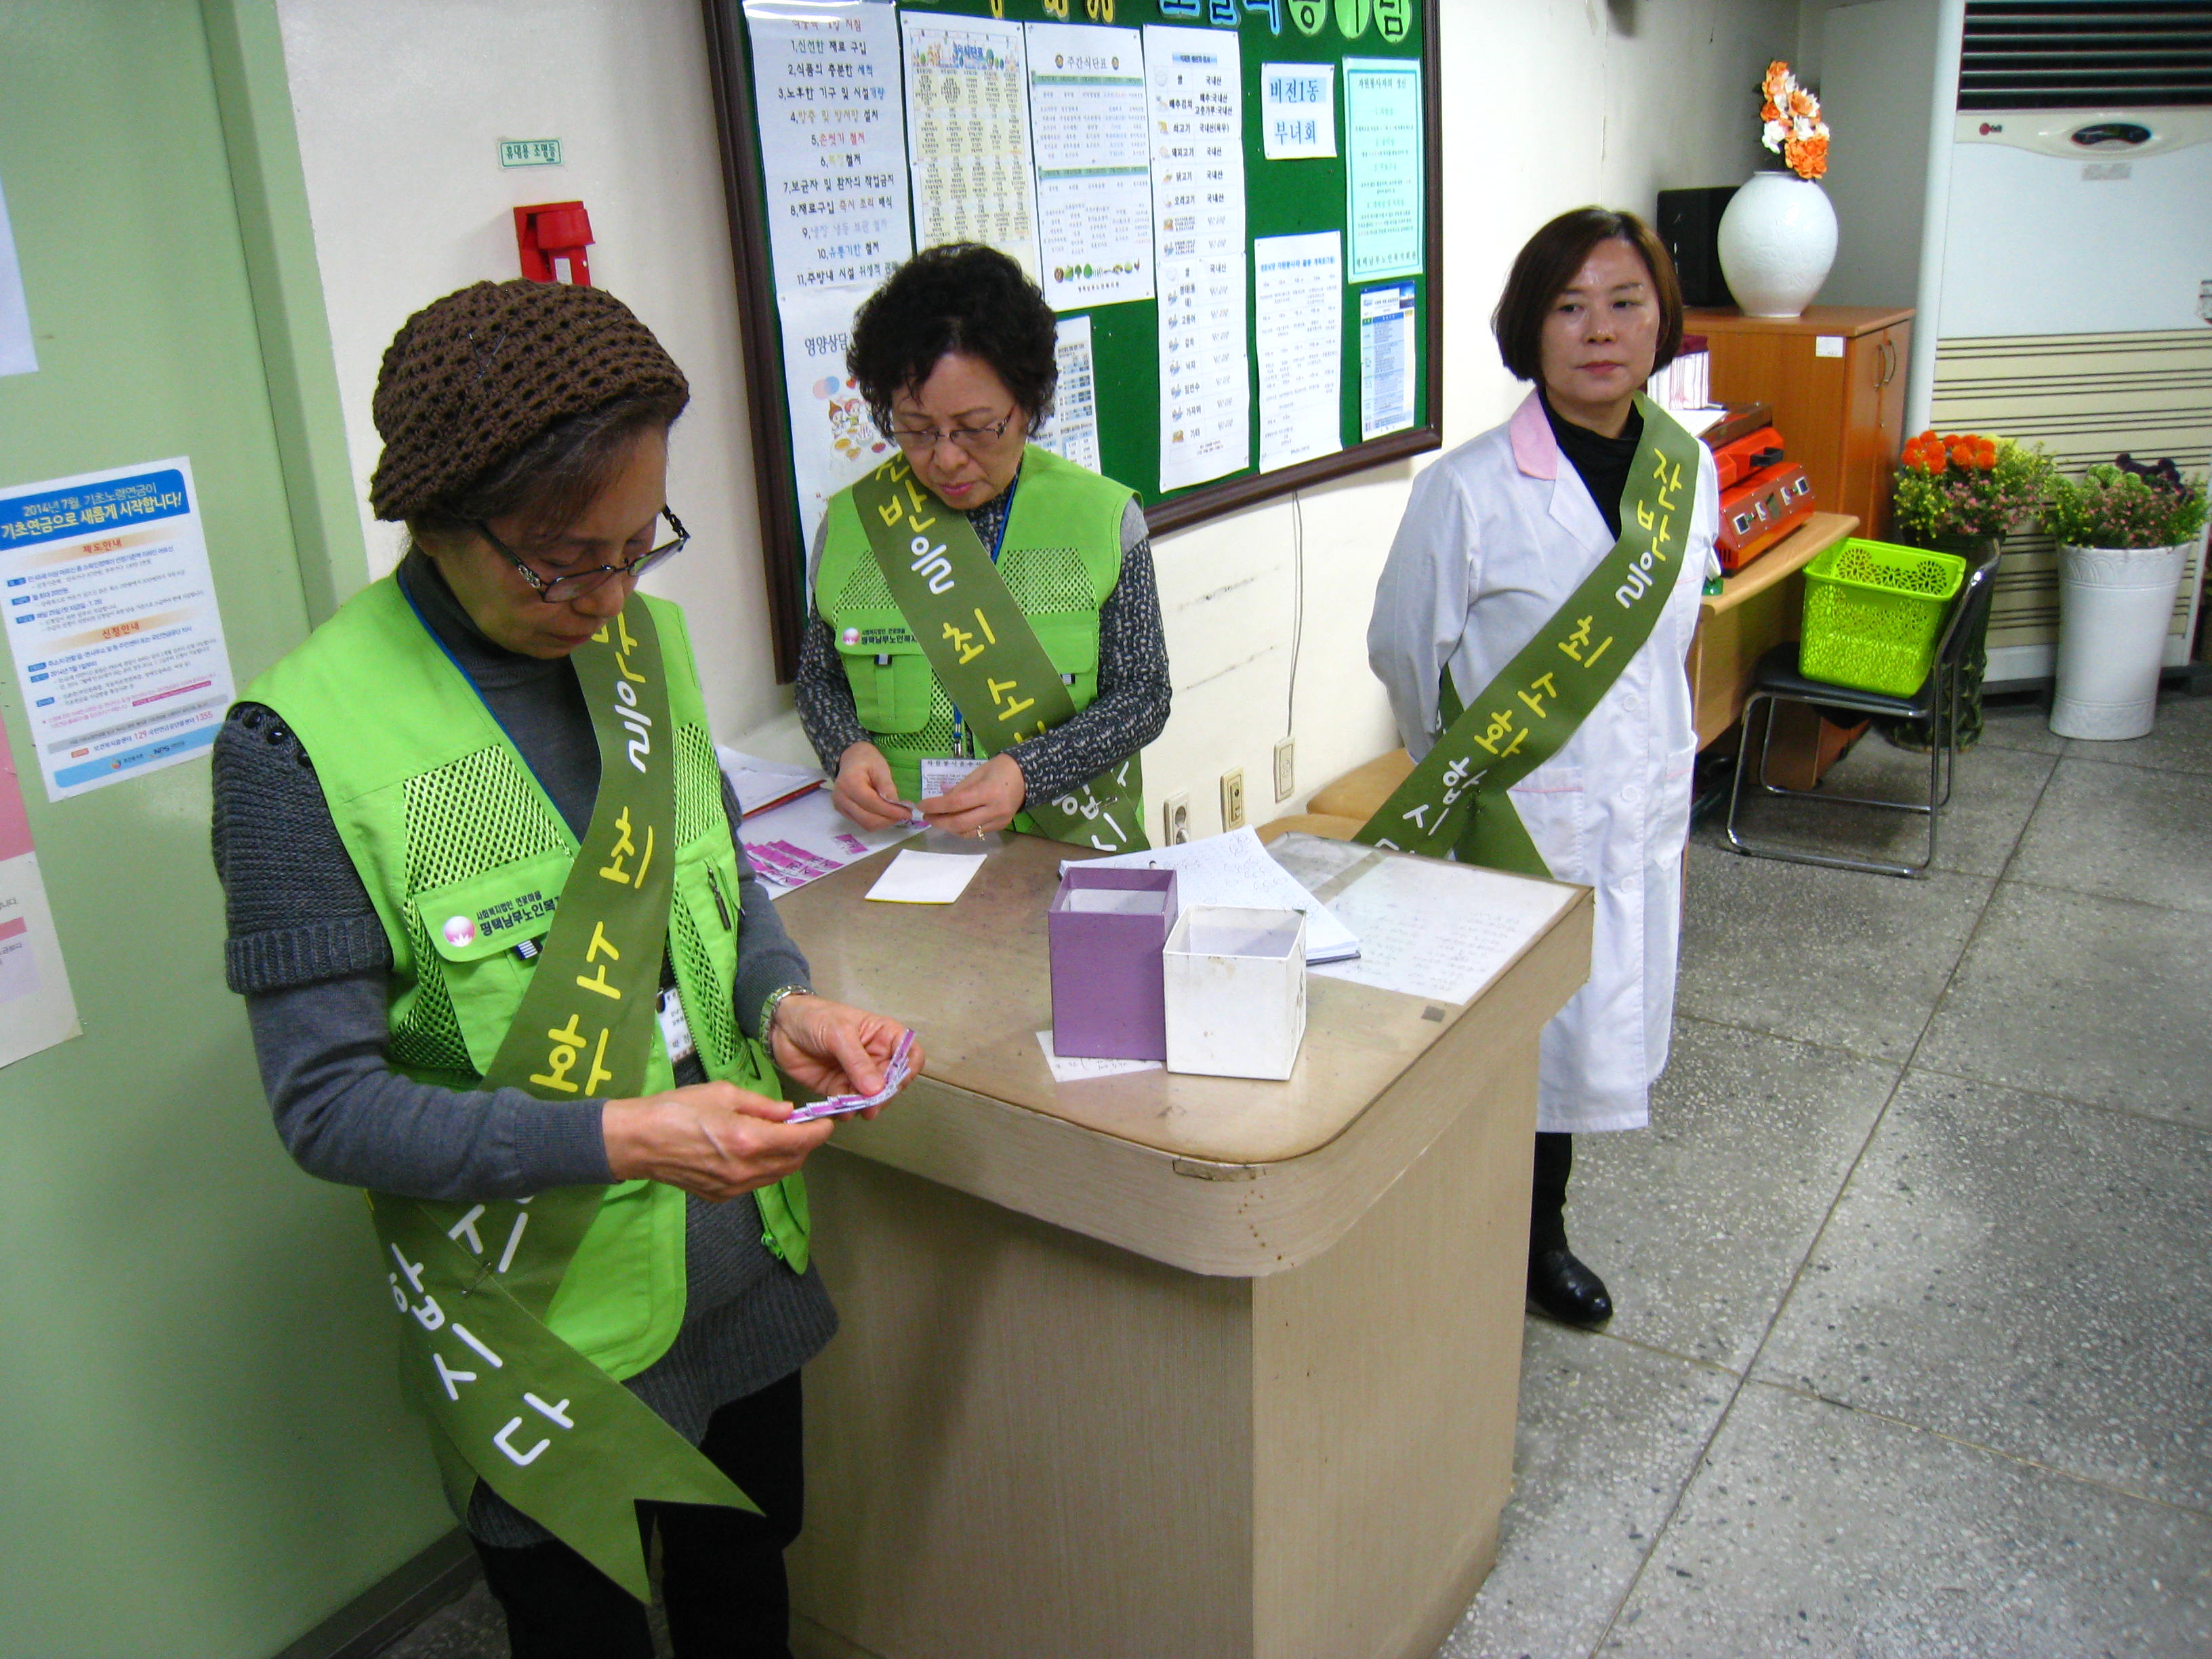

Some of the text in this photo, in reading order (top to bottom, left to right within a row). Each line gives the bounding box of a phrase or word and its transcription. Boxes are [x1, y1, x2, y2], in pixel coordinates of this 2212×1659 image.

[830, 41, 846, 53] 재료
[851, 41, 867, 55] 구입
[828, 64, 853, 77] 충분한
[1067, 56, 1107, 70] 주간식단표
[1206, 75, 1221, 86] 국내산
[820, 87, 836, 99] 기구
[1271, 79, 1319, 104] 비전1동
[1169, 98, 1192, 109] 배추김치
[1173, 123, 1190, 134] 쇠고기
[1275, 121, 1315, 145] 부녀회
[1172, 147, 1222, 157] 돼지고기 국내산
[837, 177, 861, 190] 환자의
[865, 173, 894, 188] 작업금지
[1176, 170, 1223, 182] 닭고기 국내산
[1174, 193, 1224, 205] 오리고기 국내산
[840, 267, 855, 281] 시설
[1210, 263, 1226, 273] 국내산
[805, 333, 848, 356] 영양상담
[24, 502, 60, 517] 2014년
[84, 482, 157, 506] 기초노령연금이
[1, 491, 182, 539] 기초연금으로 새롭게 시작합니다!
[1616, 447, 1682, 609] 잔반을
[83, 538, 122, 554] 제도안내
[102, 621, 141, 639] 신청안내
[1474, 615, 1614, 758] 최소화
[134, 729, 148, 741] 129
[195, 711, 213, 723] 1355
[476, 890, 542, 921] 사회복지법인 연꽃마을
[480, 896, 558, 937] 평택남부노인복
[529, 804, 654, 1096] 최소화
